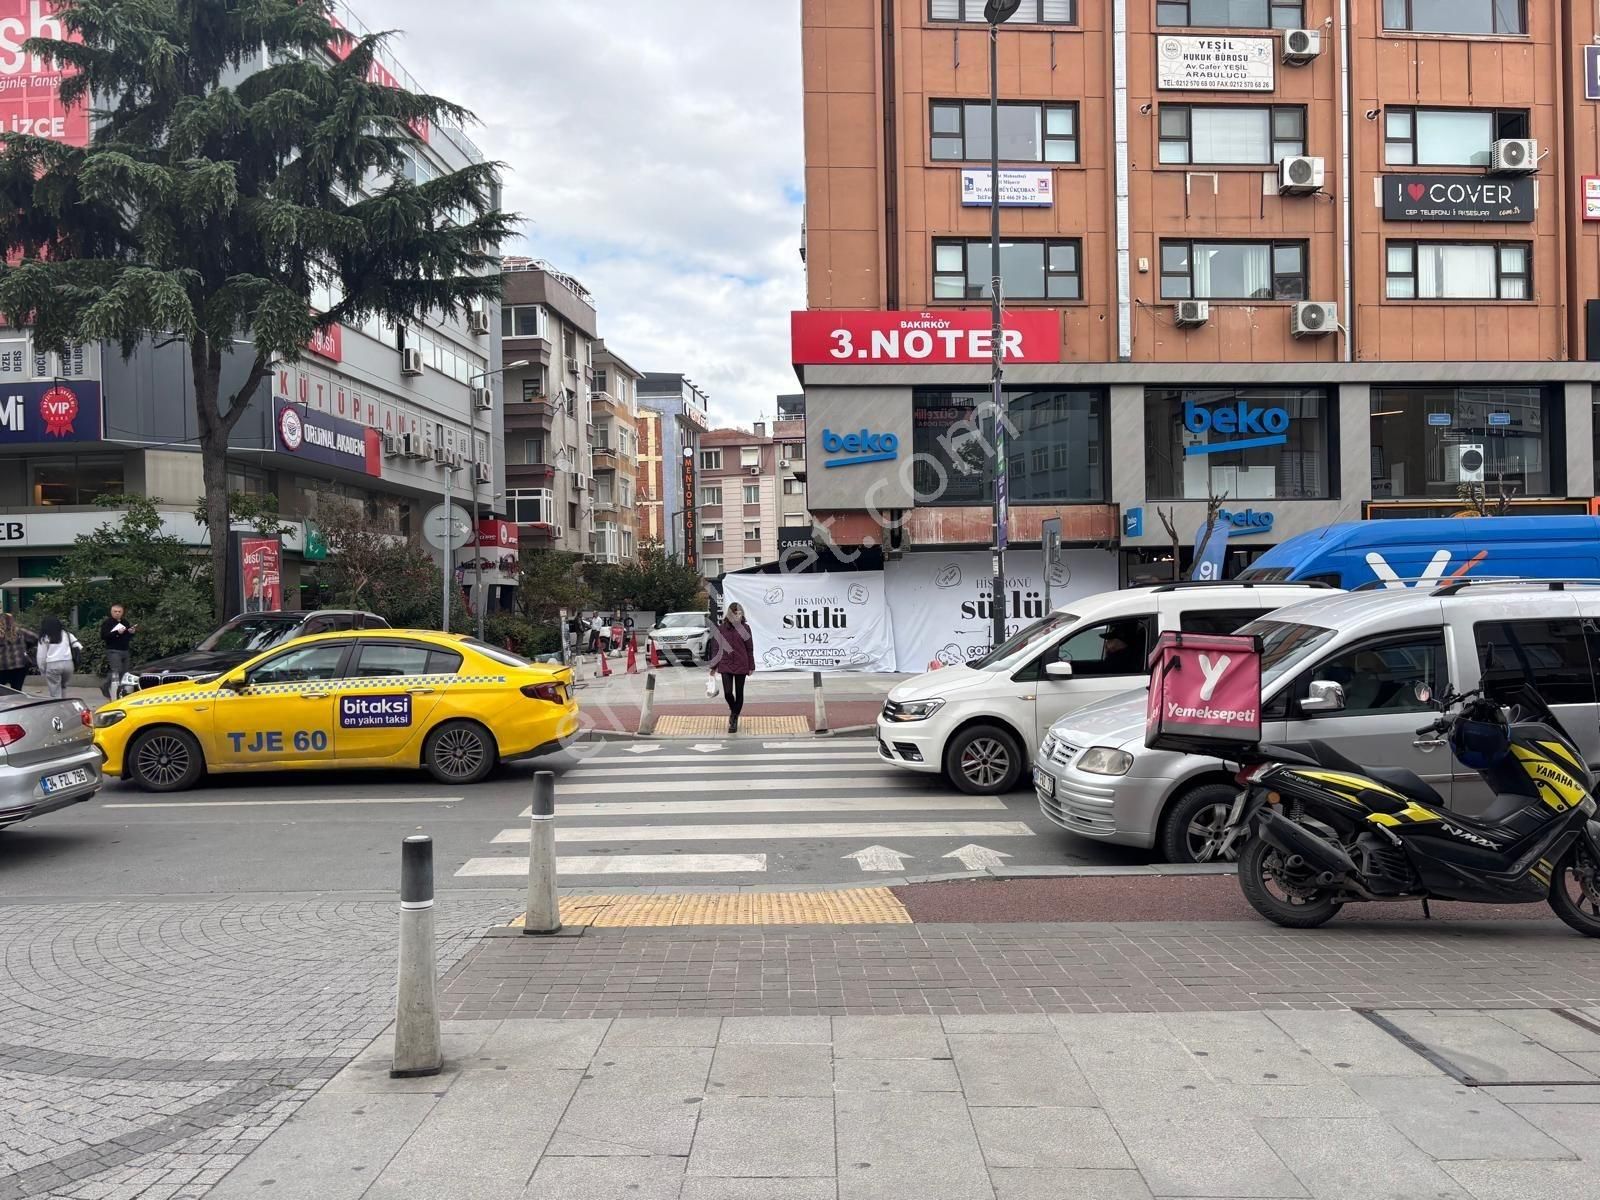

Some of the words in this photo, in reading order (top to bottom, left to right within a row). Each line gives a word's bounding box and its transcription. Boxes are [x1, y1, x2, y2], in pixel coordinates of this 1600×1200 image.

[1199, 39, 1234, 52] YEŞİL
[1215, 53, 1248, 61] BÜROSU
[1430, 184, 1512, 204] COVER
[900, 319, 951, 329] BAKIRKÖY
[829, 329, 1024, 359] 3.NOTER
[49, 402, 70, 415] VIP
[1185, 400, 1289, 434] beko
[823, 429, 898, 453] beko
[684, 459, 692, 507] MENTOR
[1218, 508, 1274, 527] beko
[976, 577, 1031, 588] HİSRÖNÜ
[795, 597, 838, 605] HİSARÖNÜ
[783, 606, 846, 629] sütlü
[803, 632, 829, 644] 1942
[986, 624, 1019, 637] 142
[787, 649, 807, 659] ÇOK
[806, 648, 846, 657] YAKINDA
[795, 658, 834, 666] SİZLERLE
[344, 698, 408, 715] bitaksi
[1167, 702, 1255, 723] Yemeksepeti
[358, 716, 383, 727] yakın
[385, 715, 408, 724] taksi
[227, 731, 284, 753] TJE
[293, 730, 327, 751] 60
[47, 777, 57, 790] 34
[1536, 764, 1573, 788] YAMAHA
[1441, 823, 1503, 850] NMAX
